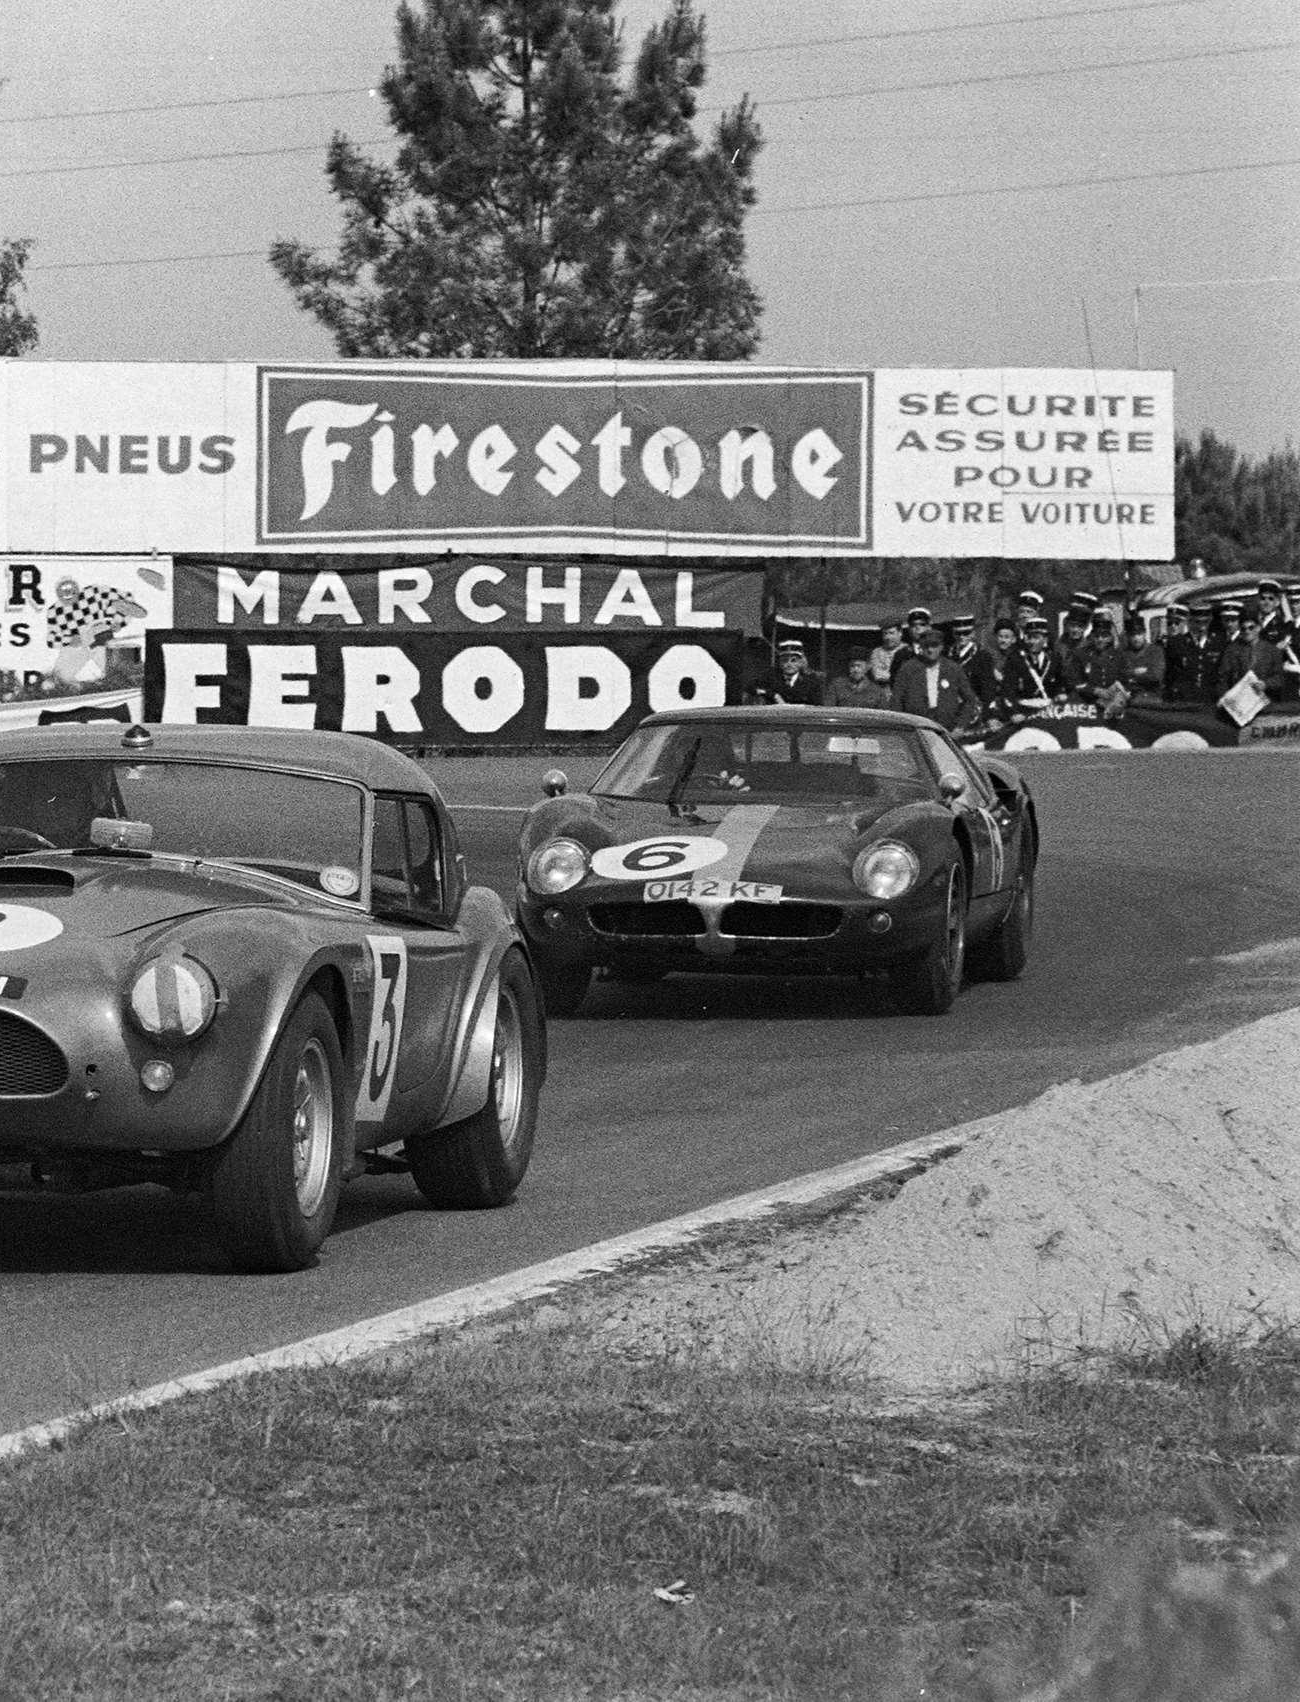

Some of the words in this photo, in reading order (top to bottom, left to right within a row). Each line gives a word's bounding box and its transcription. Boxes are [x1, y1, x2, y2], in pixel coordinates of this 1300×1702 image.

[28, 433, 237, 475] PNEUS
[285, 400, 844, 521] Firestone
[954, 465, 1094, 488] POUR
[895, 501, 1005, 524] VOTRE
[1020, 502, 1156, 525] VOITURE
[215, 564, 726, 629] MARCHAL
[161, 641, 727, 734] FERODO
[622, 841, 691, 871] 6
[368, 952, 401, 1103] 3
